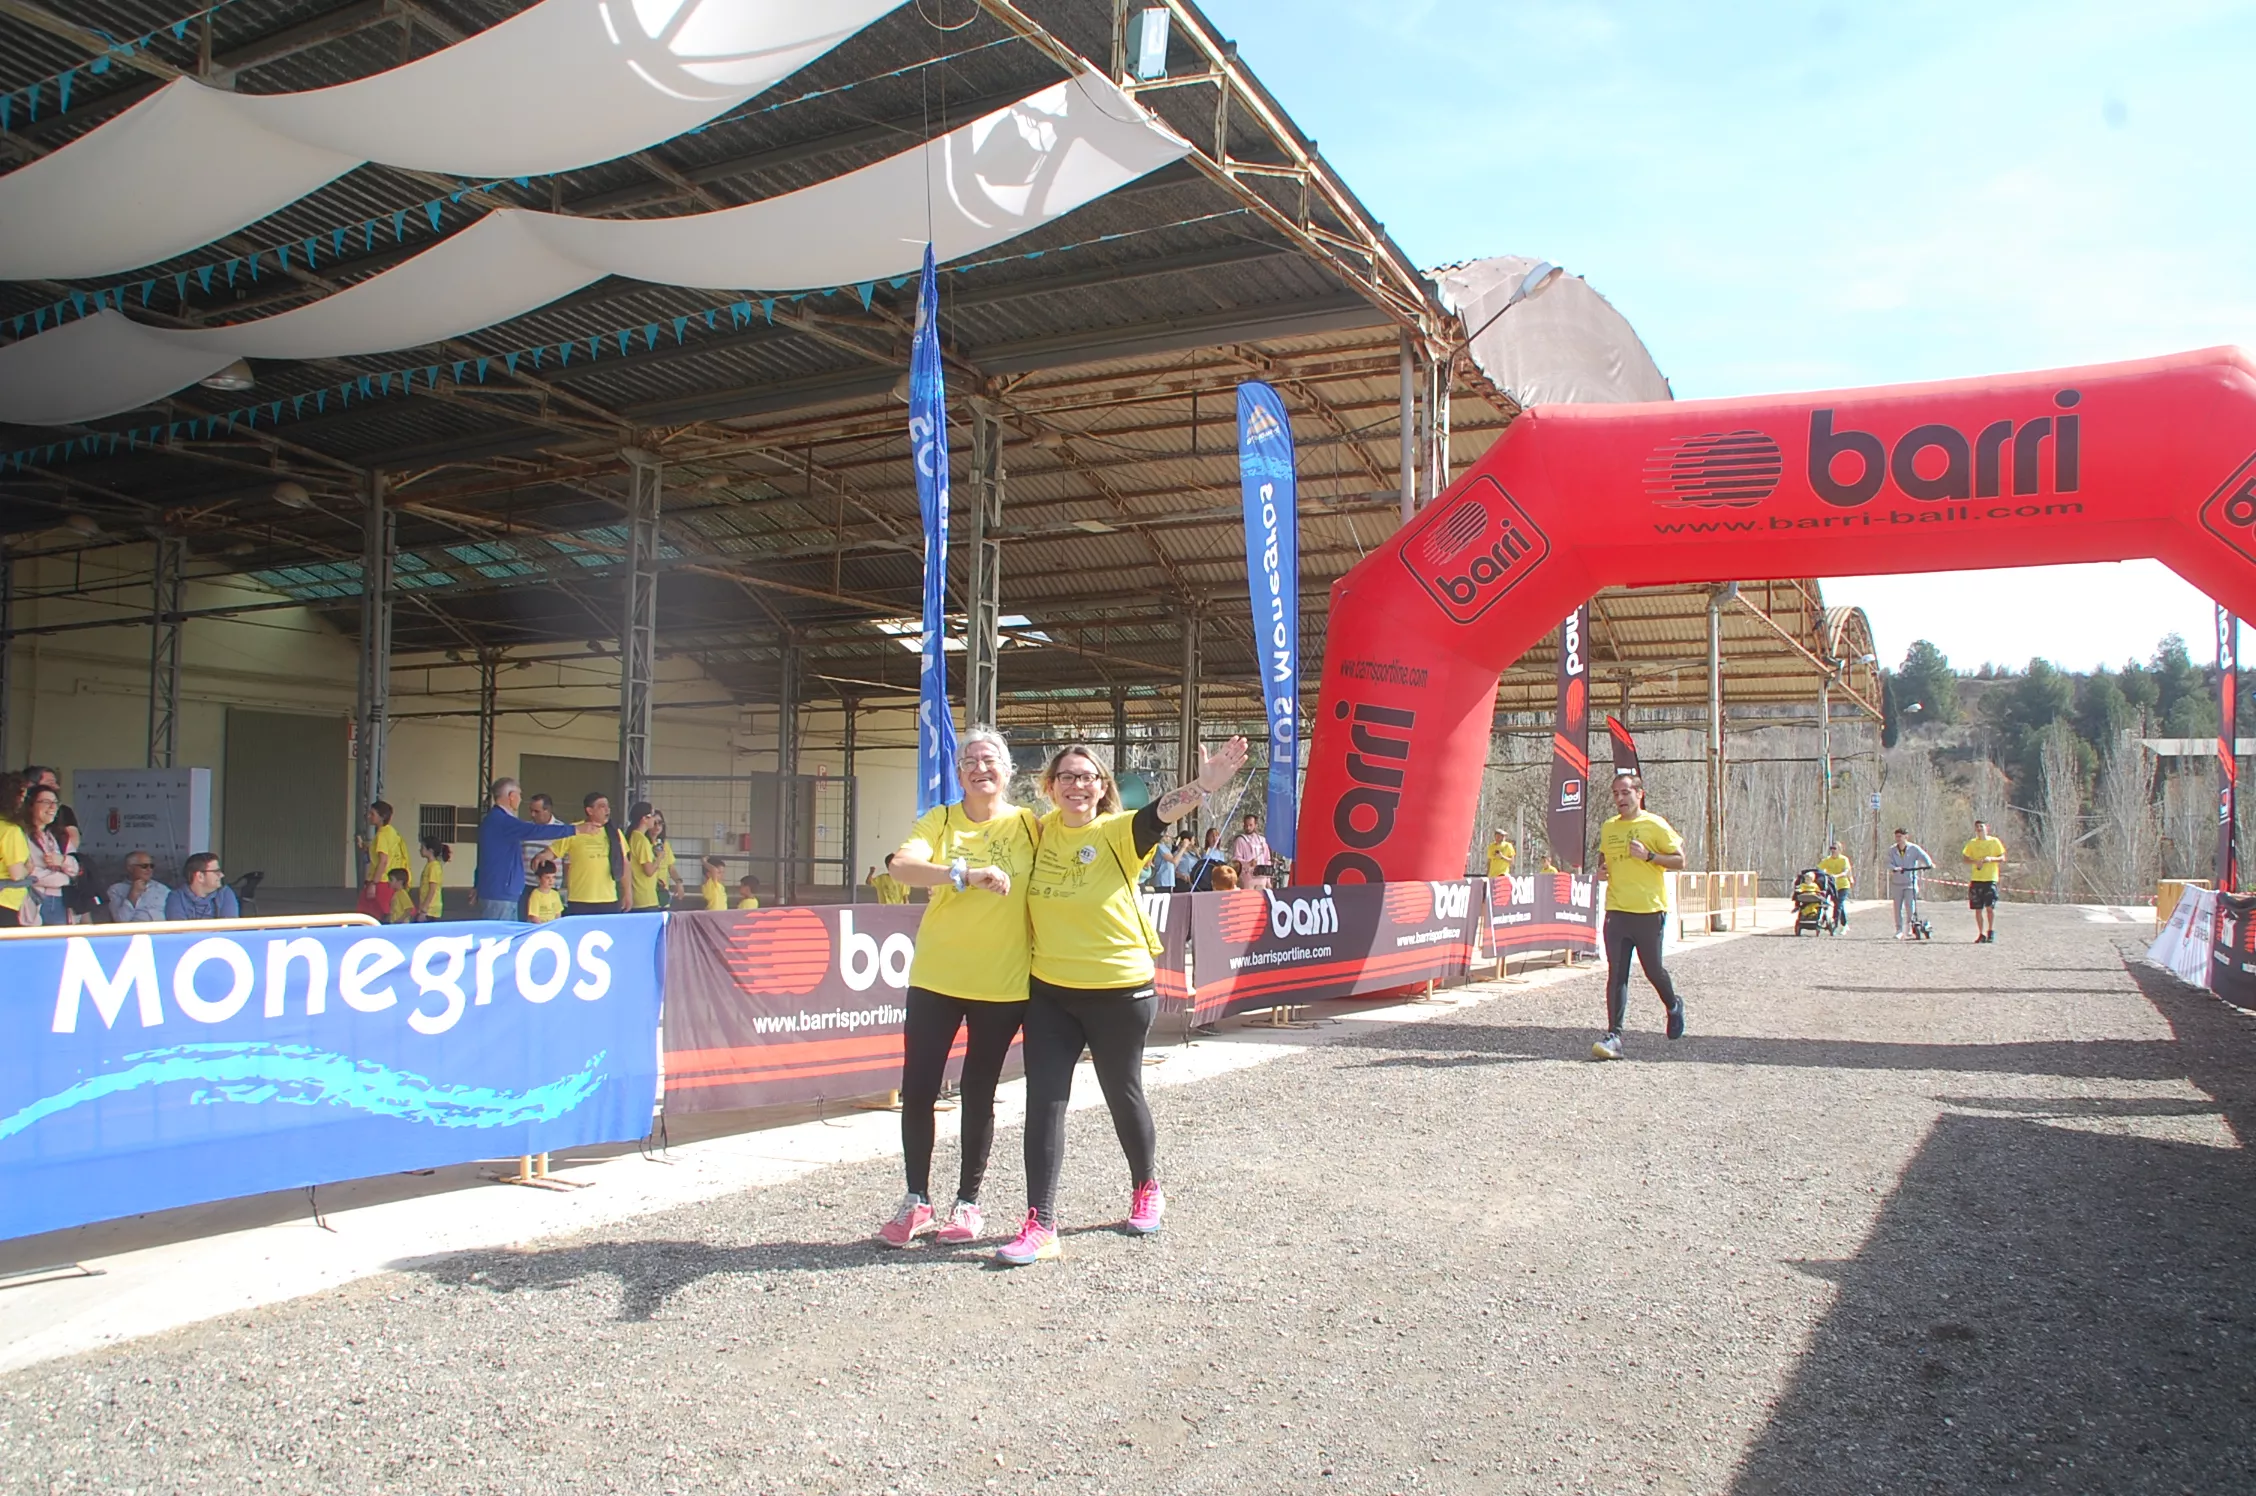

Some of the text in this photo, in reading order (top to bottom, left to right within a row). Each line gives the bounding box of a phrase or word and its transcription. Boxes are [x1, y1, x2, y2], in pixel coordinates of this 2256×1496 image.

[1806, 389, 2081, 508] barri
[1654, 502, 2084, 533] www.barri-ball.com
[1434, 518, 1532, 606] barri
[1265, 884, 1339, 939] barri
[1430, 878, 1471, 920] barri
[51, 930, 614, 1035] Monegros
[1229, 945, 1332, 970] www.barrisportline.com
